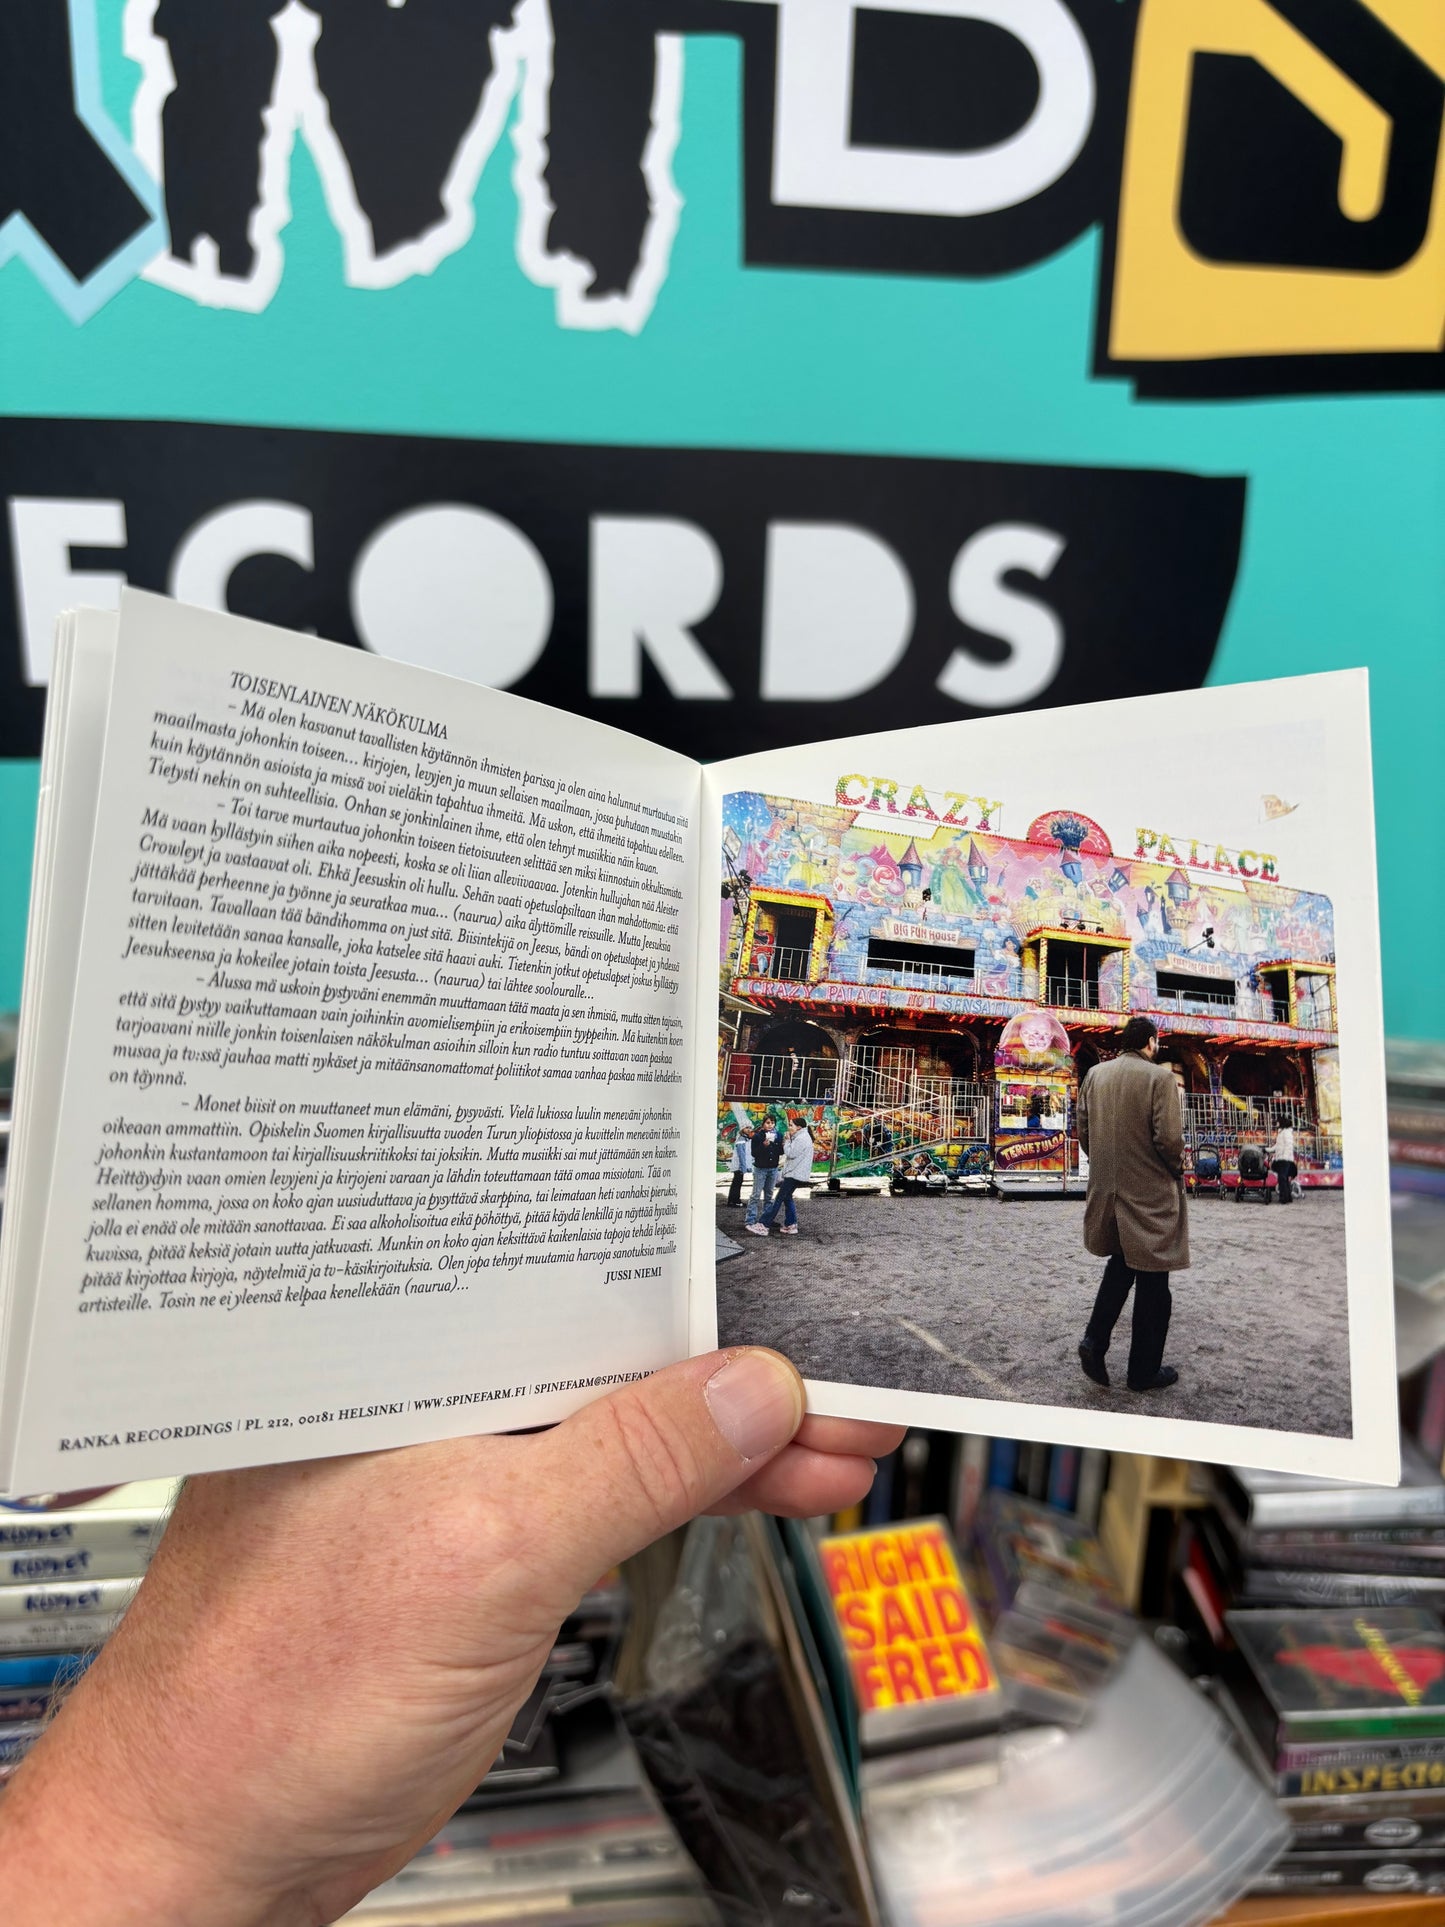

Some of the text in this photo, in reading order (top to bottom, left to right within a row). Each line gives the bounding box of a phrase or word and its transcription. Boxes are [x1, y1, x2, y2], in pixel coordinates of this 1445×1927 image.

[231, 671, 448, 740] TOISENLAINEN NÄKÖKULMA
[154, 712, 236, 745] maailmasta
[235, 726, 298, 752] johonkin
[362, 751, 410, 779] kirjojen,
[414, 763, 452, 790] levyjen
[499, 785, 538, 806] sellaisen
[540, 798, 592, 821] maailmaan,
[300, 712, 556, 789] kasvanut tavallisten käytännön ihmisten parissa
[186, 738, 526, 824] käytännön asioista vieläkin tapahtua ihmeitä.
[149, 756, 616, 864] Tietysti suhteellisia. jonkinlainen musiikkia
[836, 774, 1279, 882] CRAZY PALACE
[210, 819, 274, 848] kyllästyin
[348, 848, 400, 868] nopeesti,
[493, 869, 559, 893] alleviivaavaa.
[560, 880, 598, 900] Jotenkin
[292, 814, 361, 842] murtautua
[359, 824, 415, 846] johonkin
[418, 834, 456, 854] toiseen
[458, 842, 522, 866] tietoisuuteen
[522, 854, 558, 872] selittää
[196, 871, 615, 942] perheenne seuratkaa (naurua) älyttömille reissuille.
[225, 852, 596, 920] vastaavat Jeesuskin opetuslapsiltaan
[132, 888, 203, 911] tarvitaan.
[211, 894, 277, 920] Tavallaan
[306, 908, 388, 933] bändihomma
[457, 929, 515, 954] Biisintekijä
[529, 939, 560, 957] Jeesus,
[172, 915, 240, 940] levitetään
[287, 929, 342, 954] kansalle,
[376, 940, 422, 960] katselee
[508, 956, 552, 979] Tietenkin
[894, 923, 909, 936] BIG
[929, 930, 957, 942] HOUSE
[121, 936, 216, 968] Jeesukseensa
[236, 948, 290, 975] kokeilee
[434, 968, 485, 990] (naurua)
[320, 984, 618, 1023] pystyväni enemmän muuttamaan ihmisiä,
[749, 981, 814, 999] CRAZY
[826, 985, 886, 1005] PALACE
[116, 1016, 194, 1039] tarjoavani
[280, 1028, 354, 1046] toisenlaisen
[357, 1031, 430, 1050] näkökulman
[433, 1037, 476, 1053] asioihin
[478, 1039, 509, 1055] silloin
[225, 998, 619, 1044] vaikuttamaan joihinkin avomielisempiin erikoisempiin tyyppeihin.
[312, 1052, 541, 1081] nykäset mitäänsanomattomat poliitikot
[165, 1122, 242, 1137] ammattiin.
[249, 1120, 310, 1143] Opiskelin
[367, 1123, 441, 1144] kirjallisuutta
[516, 1125, 572, 1145] yliopistossa
[299, 1101, 573, 1123] muuttaneet elämäni, pysyvästi. lukiossa
[169, 1143, 268, 1161] kustantamoon
[292, 1145, 419, 1168] kirjallisuuskriitikoksi
[434, 1146, 482, 1167] joksikin.
[522, 1146, 563, 1160] musiikki
[270, 1168, 320, 1191] levyjeni
[336, 1168, 388, 1190] kirjojeni
[484, 1170, 552, 1182] toteuttamaan
[254, 1206, 614, 1233] sanottavaa. alkoholisoitua pöhöttyä, lenkillä
[337, 1188, 596, 1211] uusiuduttava pysyttävä skarppina, leimataan
[308, 1227, 602, 1260] jatkuvasti. keksittävä kaikenlaisia
[125, 1268, 187, 1292] kirjottaa
[190, 1266, 238, 1288] kirjoja,
[243, 1263, 308, 1286] näytelmiä
[525, 1250, 575, 1264] muutamia
[230, 1288, 283, 1311] yleensä
[330, 1281, 400, 1299] kenellekään
[604, 1266, 662, 1285] JUSSI NIEMI
[58, 1434, 120, 1452] RANKA
[125, 1421, 232, 1444] RECORDINGS
[245, 1418, 264, 1431] PL
[268, 1418, 293, 1428] 212,
[298, 1411, 334, 1425] 00181
[338, 1402, 404, 1420] HELSINKI
[414, 1386, 526, 1410] WWW.SPINEFARM.FI
[821, 1528, 948, 1596] RIGHT
[845, 1583, 970, 1651] SAID
[855, 1640, 990, 1711] FRED
